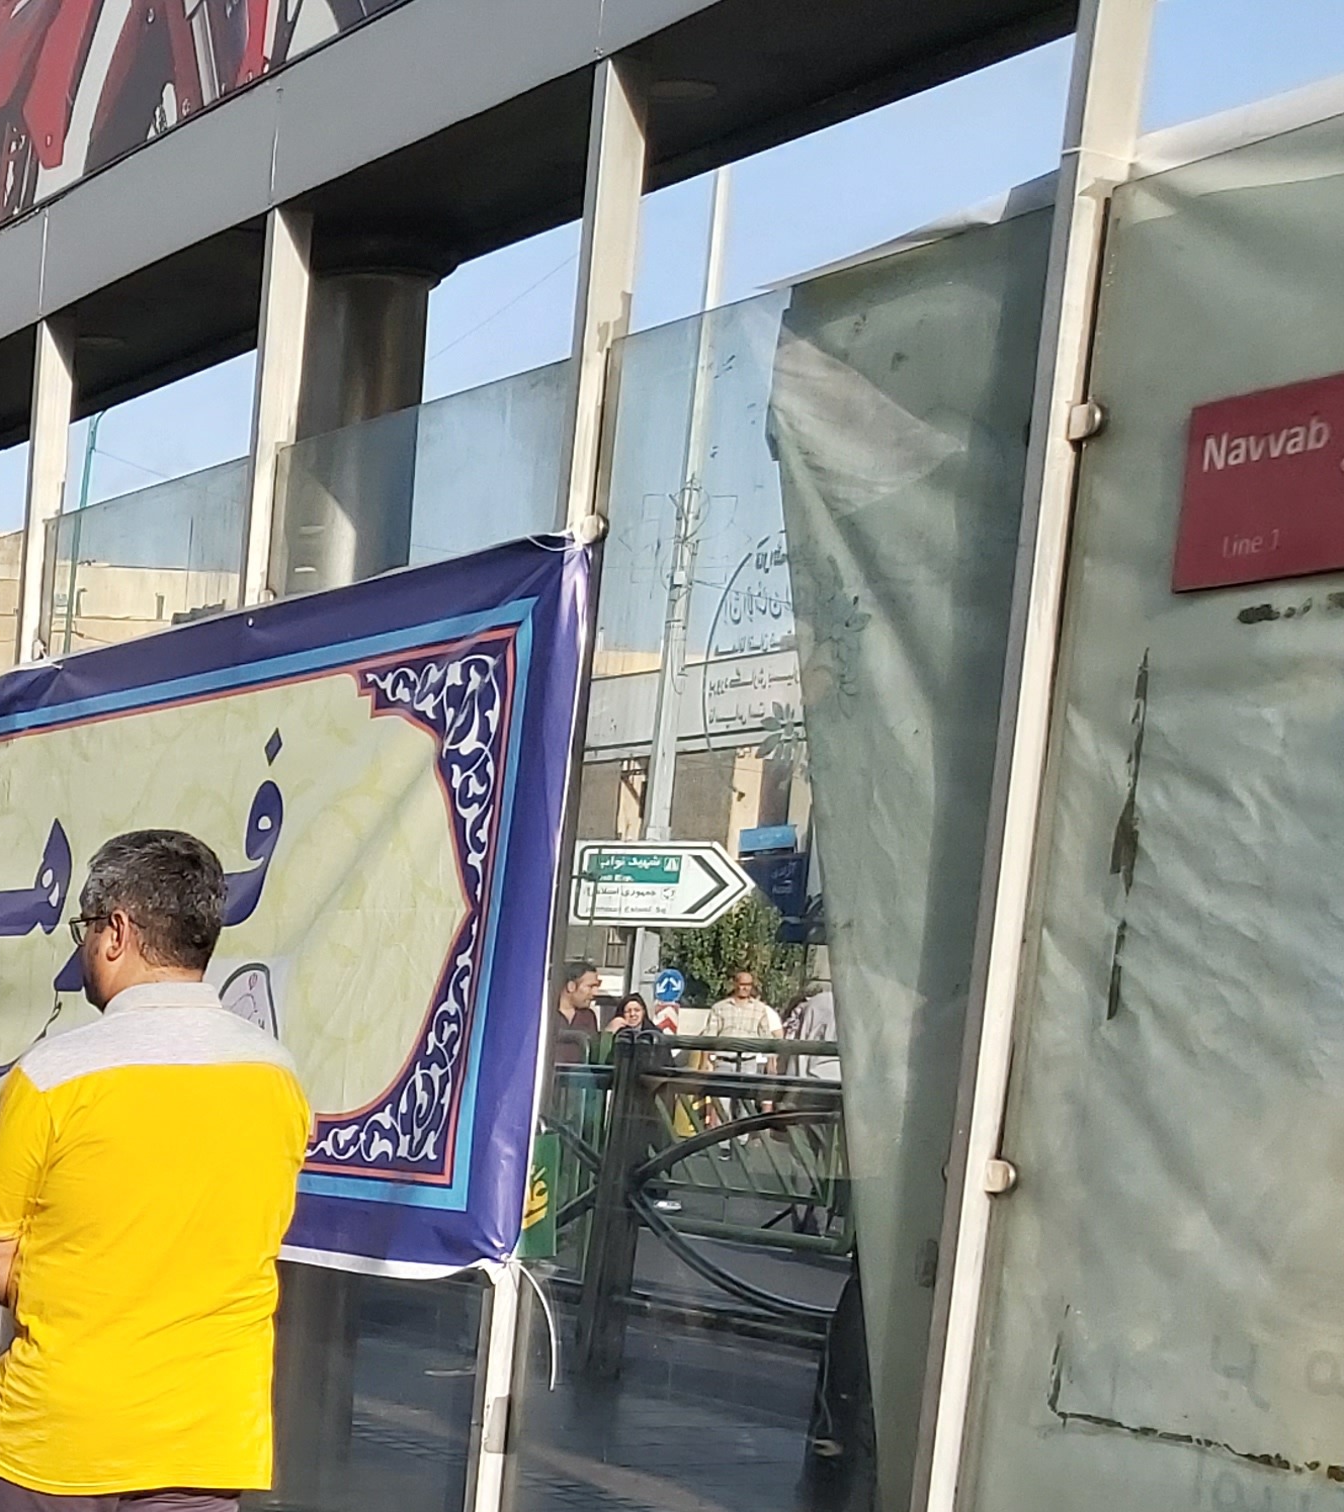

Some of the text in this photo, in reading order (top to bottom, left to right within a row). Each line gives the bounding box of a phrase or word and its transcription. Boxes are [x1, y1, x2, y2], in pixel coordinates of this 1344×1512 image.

[1202, 416, 1330, 473] Navvab
[1222, 533, 1263, 559] Line
[628, 856, 661, 869] شهید
